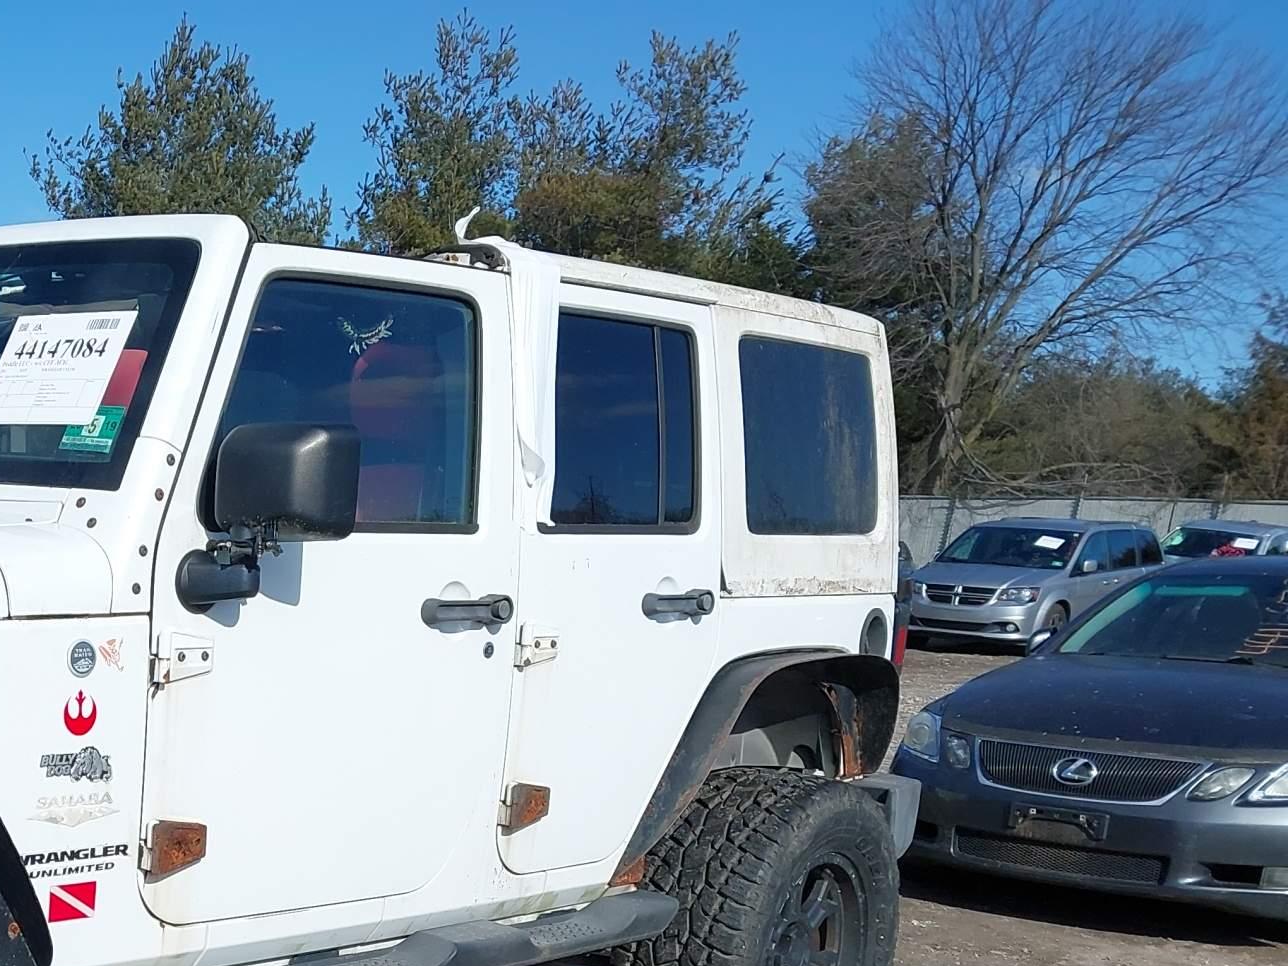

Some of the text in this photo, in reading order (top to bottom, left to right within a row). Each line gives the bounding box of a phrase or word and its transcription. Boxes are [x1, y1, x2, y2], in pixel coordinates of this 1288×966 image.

[14, 337, 110, 359] 44147084
[40, 753, 77, 767] BULLY
[45, 765, 72, 778] DOG
[36, 791, 113, 809] SAHARA
[29, 862, 115, 879] UNLIMITED
